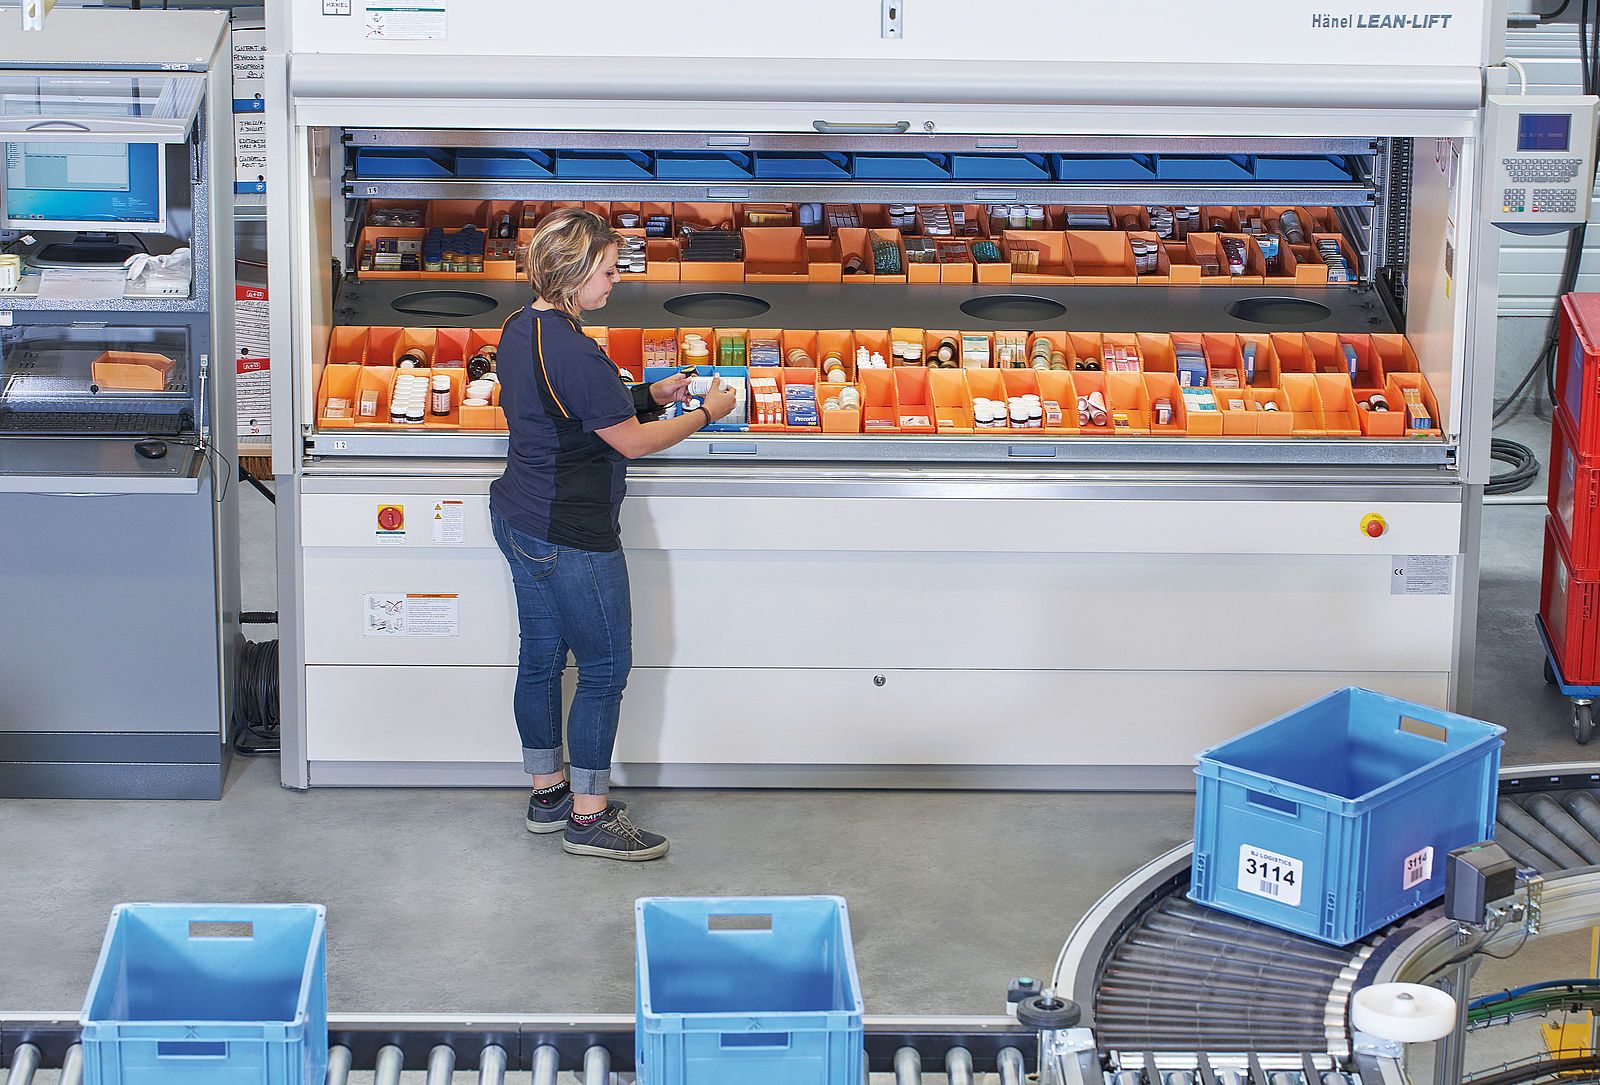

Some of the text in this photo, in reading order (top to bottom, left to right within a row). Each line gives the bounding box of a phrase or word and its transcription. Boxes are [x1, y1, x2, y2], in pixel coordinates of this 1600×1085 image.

[1312, 14, 1453, 29] Hänel LEAN-LIFT
[1260, 853, 1292, 867] LOGISTICS
[1407, 851, 1427, 870] 3114
[1246, 858, 1295, 886] 3114
